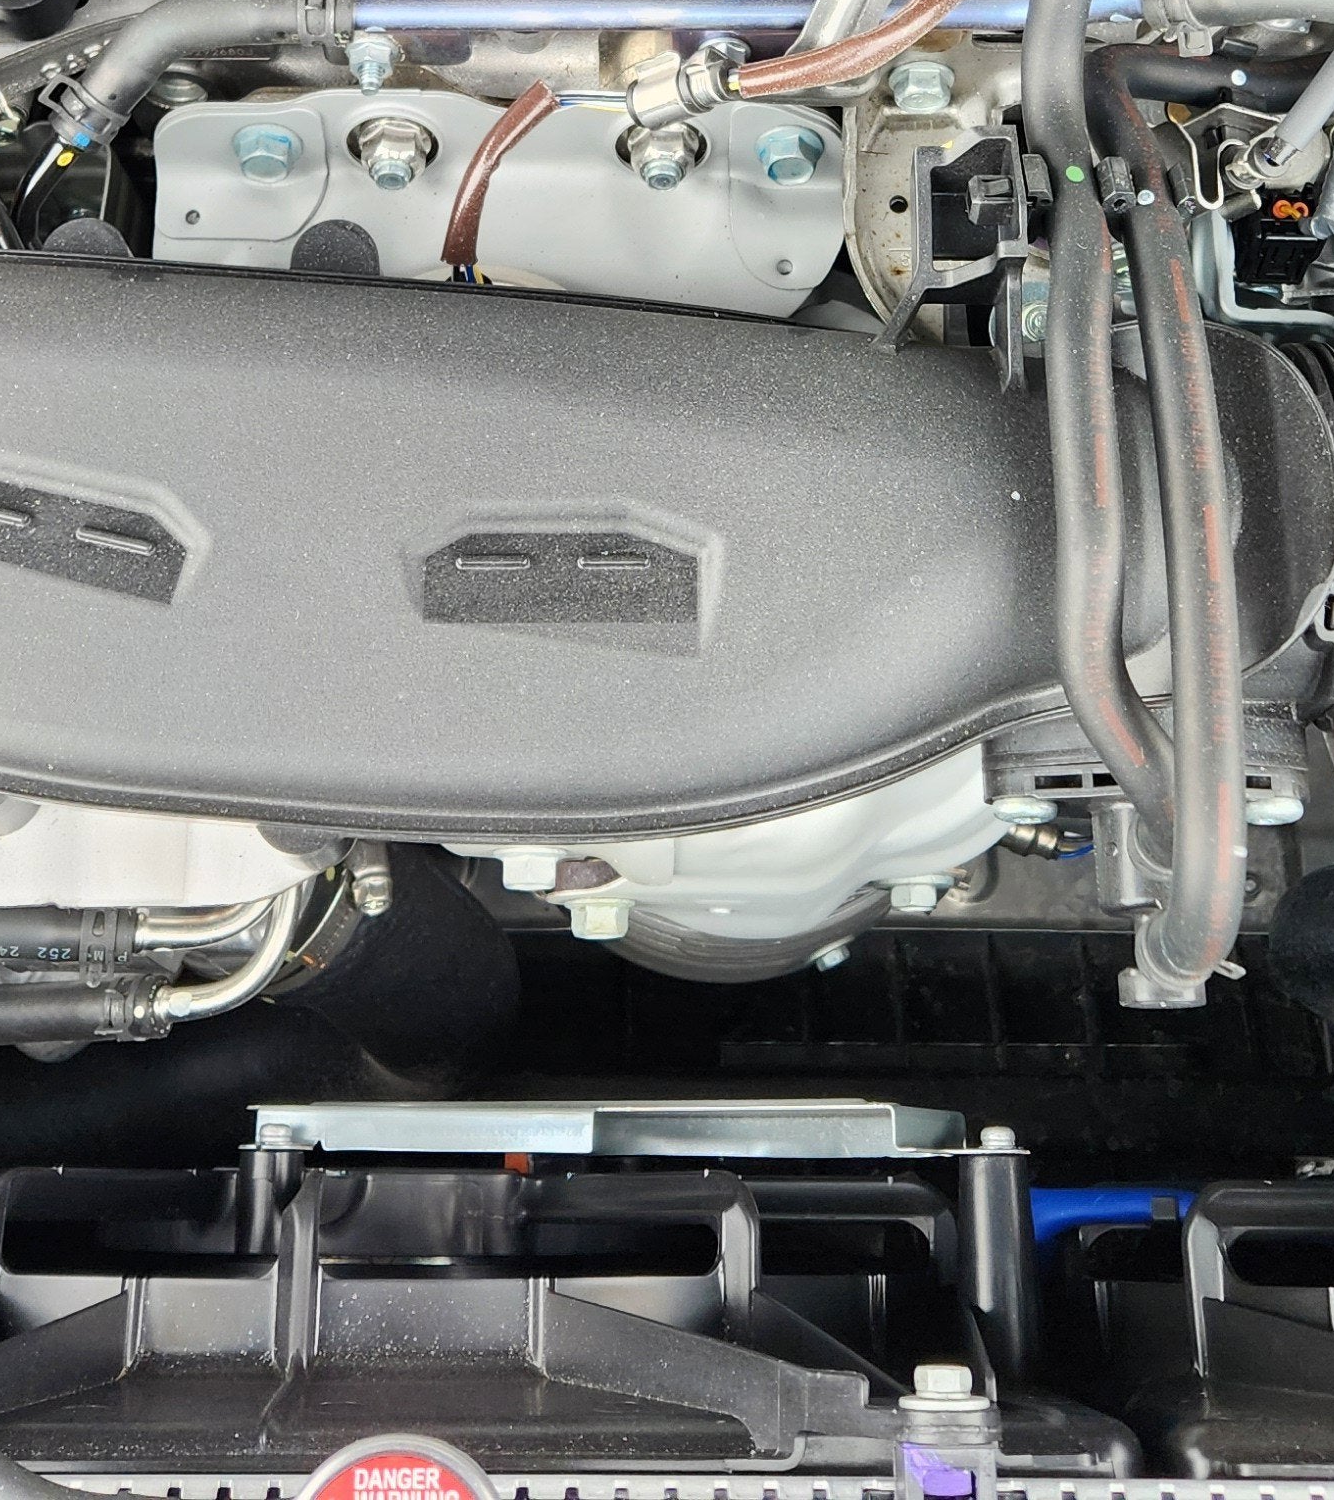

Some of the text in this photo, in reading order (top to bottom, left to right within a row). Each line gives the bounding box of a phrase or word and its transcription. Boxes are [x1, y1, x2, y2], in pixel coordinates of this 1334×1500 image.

[0, 946, 19, 957] 24
[37, 946, 71, 960] 252
[353, 1467, 441, 1490] DANGER
